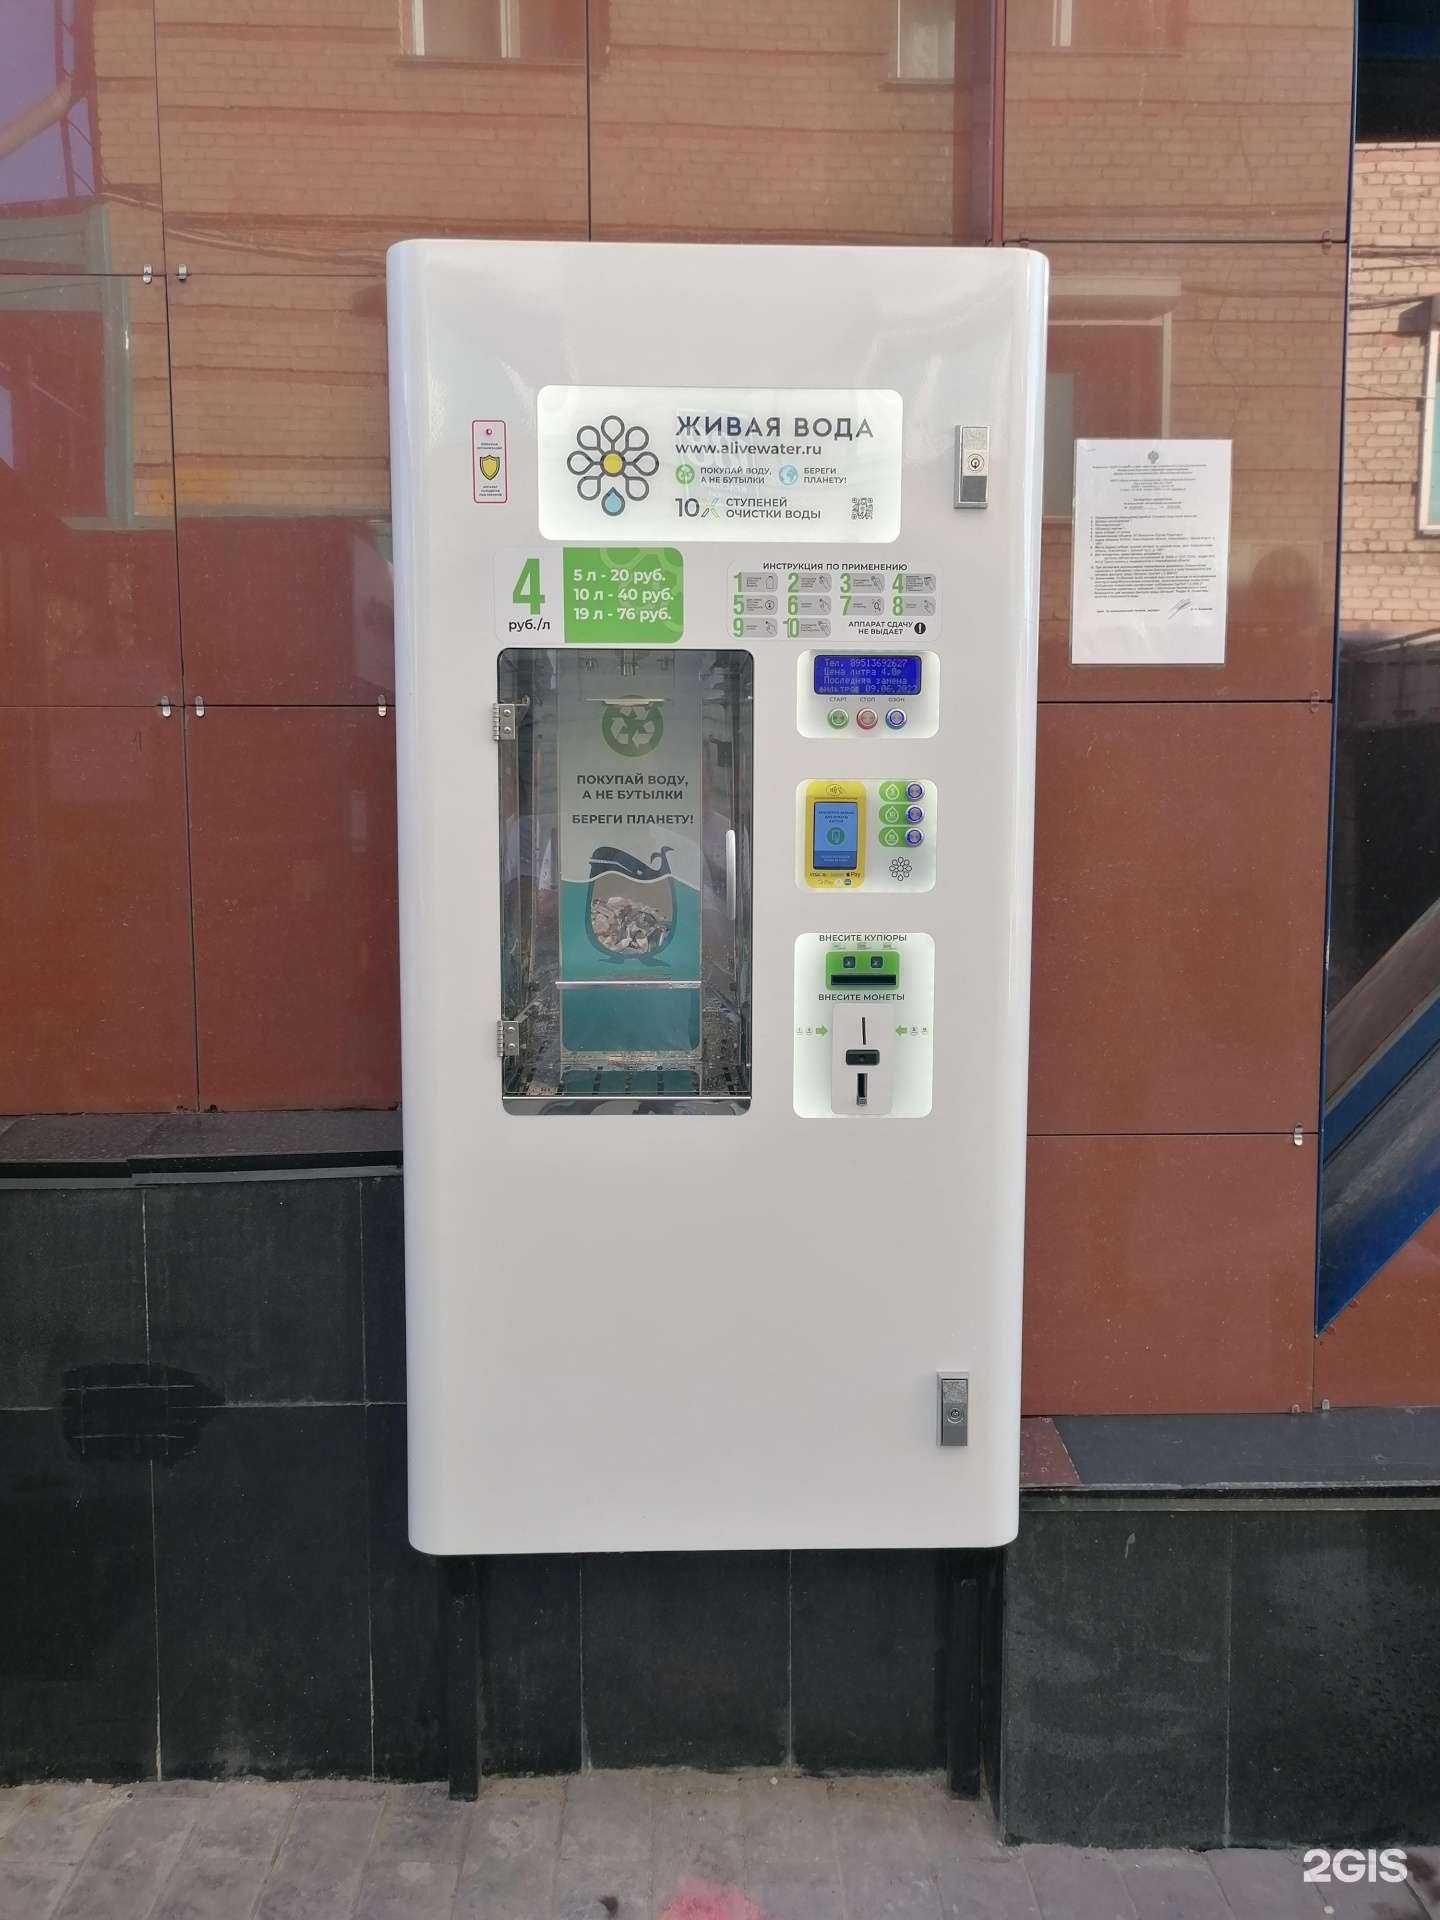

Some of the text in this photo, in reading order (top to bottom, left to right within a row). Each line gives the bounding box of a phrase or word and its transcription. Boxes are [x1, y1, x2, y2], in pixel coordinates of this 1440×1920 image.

[675, 416, 874, 441] ЖИВАЯ ВОДА
[675, 441, 822, 455] www.alivewater.ru
[700, 466, 772, 476] ПОКУПАЙ ВОДУ,
[803, 467, 837, 475] БЕРЕГИ
[700, 476, 765, 484] А НЕ БУТЫЛКИ
[803, 476, 847, 484] ПЛАНЕТУ!
[675, 498, 700, 518] 10
[726, 496, 788, 508] СТУПЕНЕЙ
[726, 509, 821, 520] ОЧИСТКИ ВОДЫ
[763, 563, 908, 572] ИНСТРУКЦИЯ ПО ПРИМЕНЕНИЮ
[573, 569, 583, 582] 5
[586, 571, 596, 582] л
[610, 569, 630, 582] 20
[633, 568, 666, 585] руб.
[733, 571, 743, 593] 1
[787, 572, 800, 593] 2
[839, 572, 851, 594] 3
[892, 573, 904, 594] 4
[512, 558, 546, 615] 4
[573, 588, 590, 601] 10
[593, 590, 604, 601] л
[617, 588, 638, 601] 40
[642, 587, 674, 604] руб.
[732, 594, 745, 615] 5
[787, 595, 798, 615] 6
[839, 595, 852, 616] 7
[892, 595, 904, 616] 8
[573, 607, 590, 620] 19
[592, 609, 604, 620] л
[616, 607, 636, 620] 76
[639, 606, 672, 623] руб.
[508, 618, 551, 632] руб./л
[732, 617, 744, 638] 9
[782, 617, 800, 638] 10
[886, 621, 914, 629] СДАЧУ
[823, 667, 846, 676] Цена
[823, 676, 872, 685] Последняя
[576, 773, 689, 787] ПОКУПАЙ ВОДУ,
[582, 790, 683, 800] А НЕ БУТЫЛКИ
[572, 814, 694, 824] БЕРЕГИ ПЛАНЕТУ!
[819, 934, 907, 942] ВНЕСИТЕ КУПЮРЫ
[818, 993, 905, 1001] ВНЕСИТЕ МОНЕТЫ
